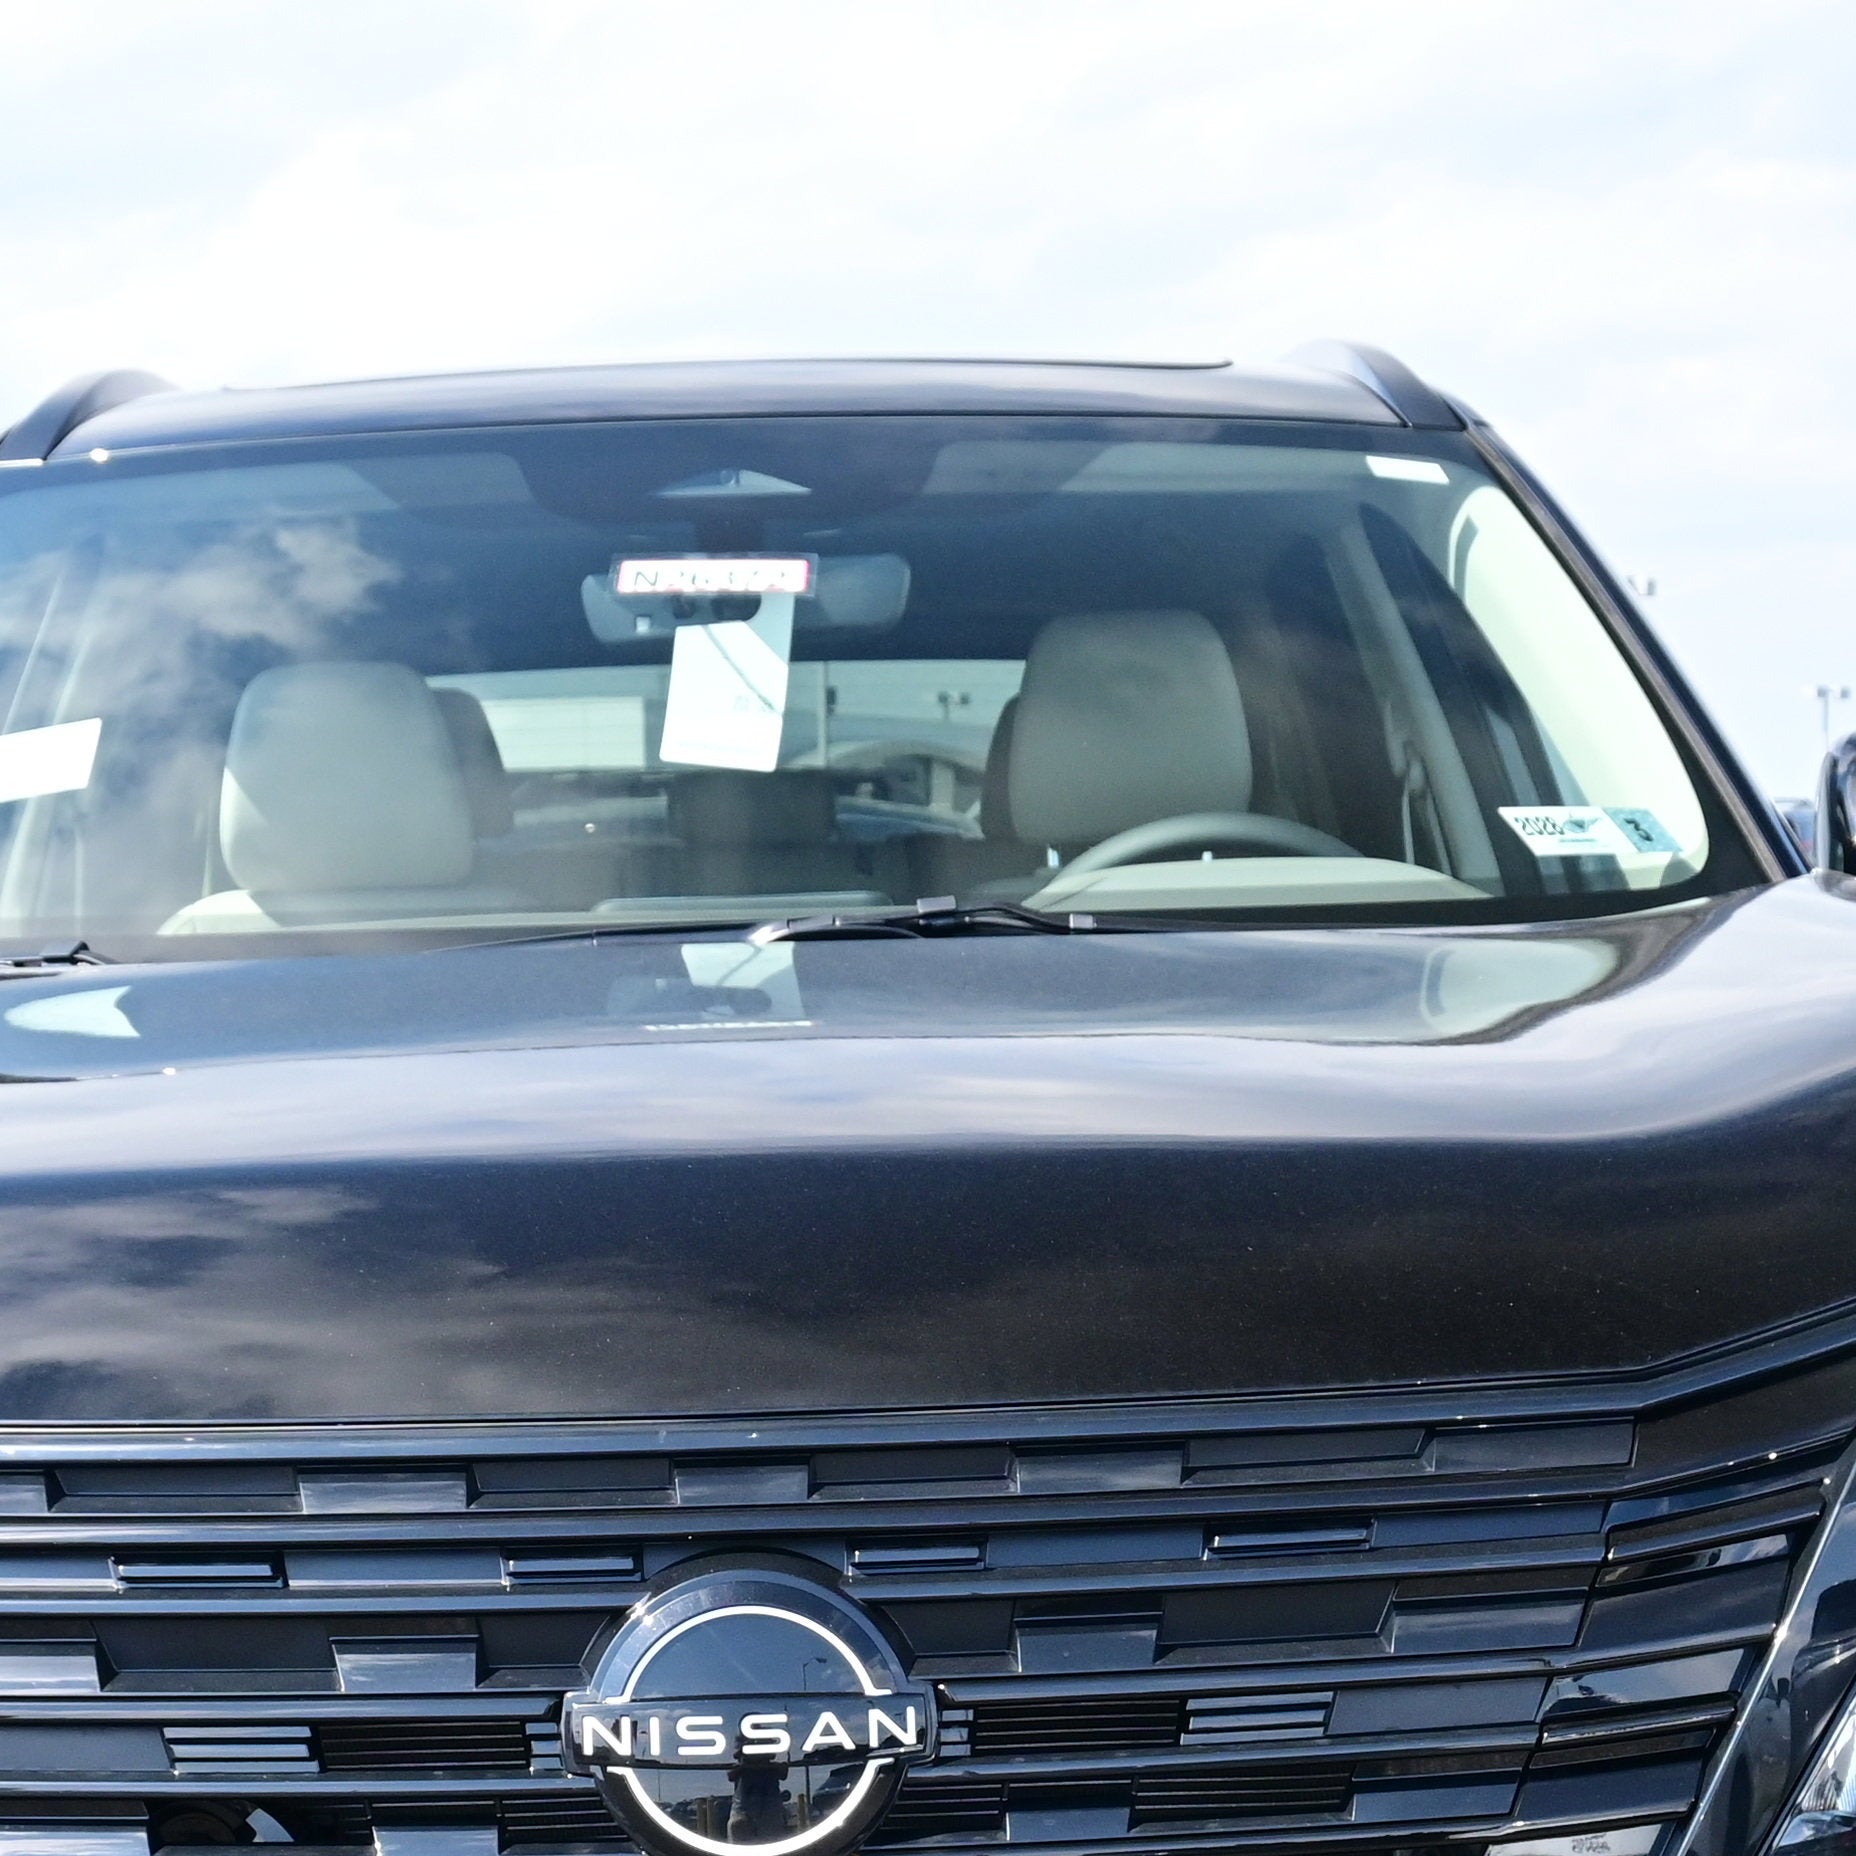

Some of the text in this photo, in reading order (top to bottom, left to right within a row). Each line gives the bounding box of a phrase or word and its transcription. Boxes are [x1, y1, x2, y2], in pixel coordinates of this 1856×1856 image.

[1514, 817, 1565, 836] 2028
[1624, 818, 1654, 842] 3
[581, 1705, 918, 1758] NISSAN
